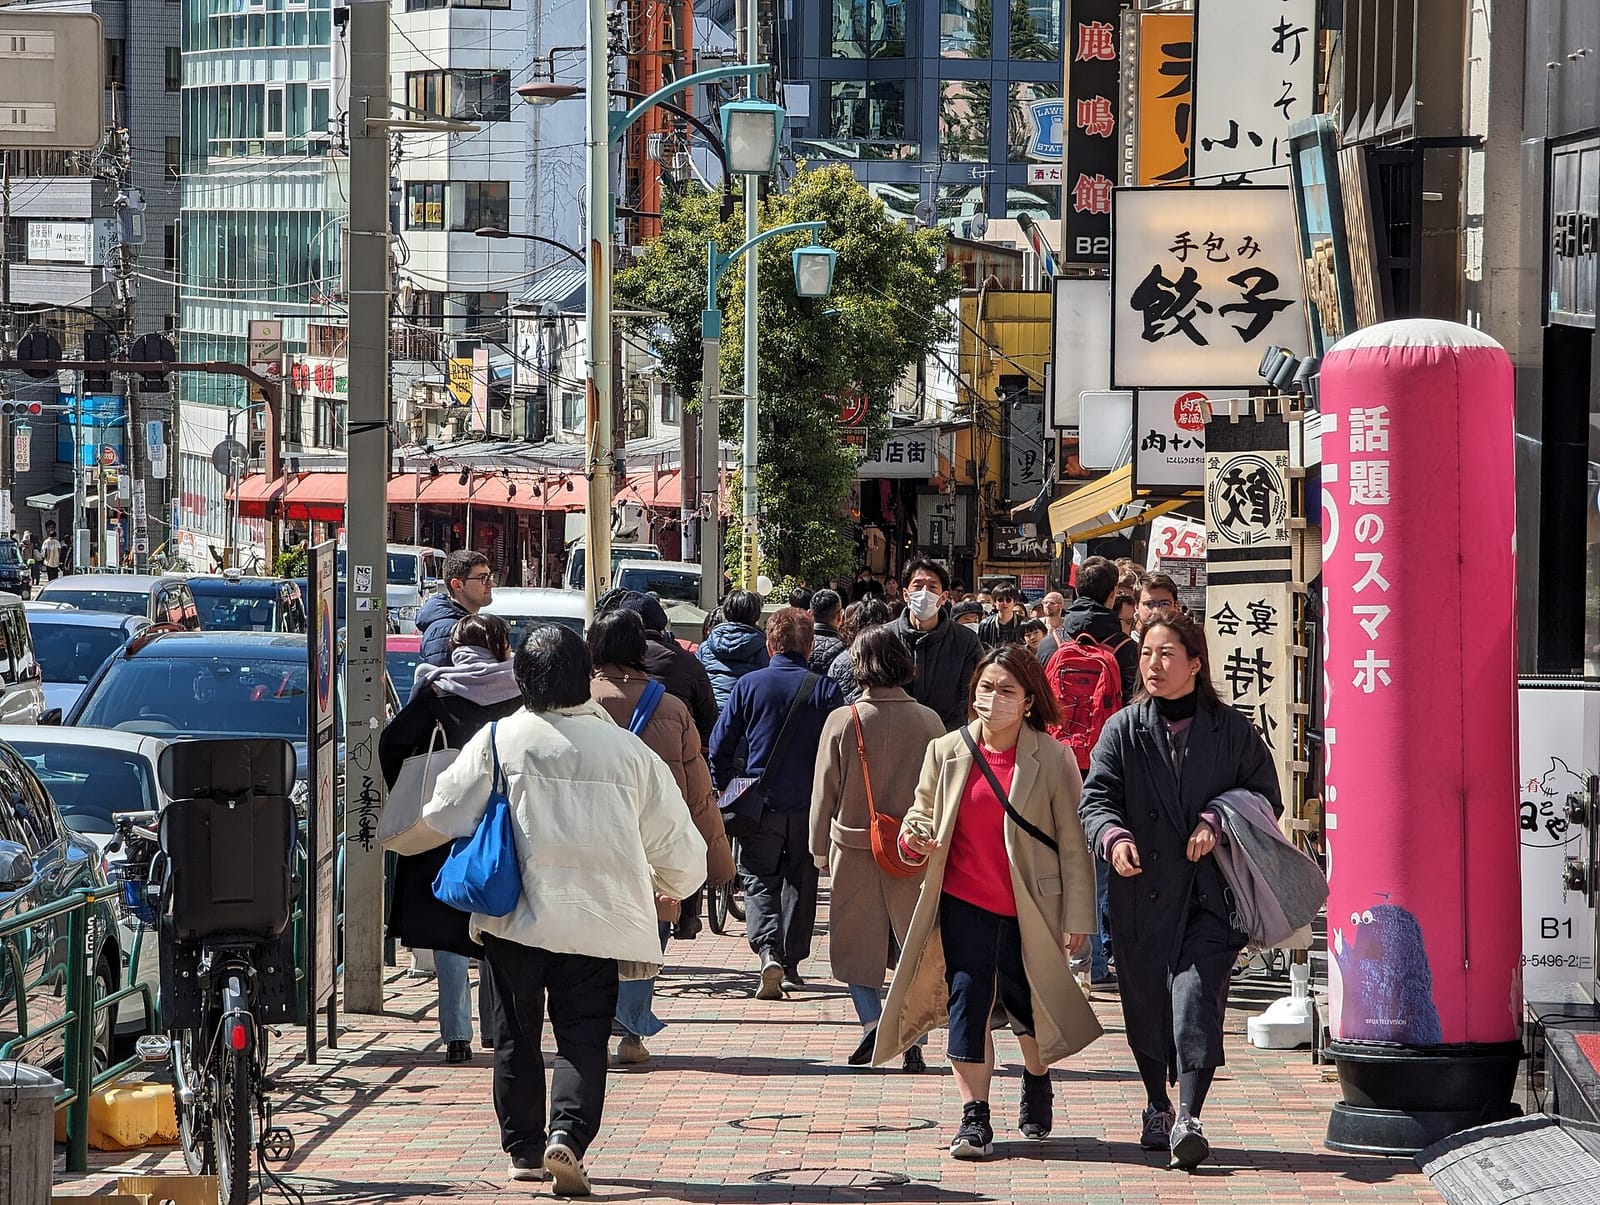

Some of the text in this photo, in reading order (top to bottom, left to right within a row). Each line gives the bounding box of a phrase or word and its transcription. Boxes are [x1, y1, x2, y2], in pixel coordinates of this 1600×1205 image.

[1072, 21, 1116, 215] 鹿鳴館
[1035, 169, 1063, 180] 酒・た
[1076, 236, 1109, 254] B2
[1168, 231, 1262, 263] 手包み
[1130, 264, 1296, 347] 餃子
[1178, 413, 1204, 424] 居酒
[1348, 405, 1392, 694] 話題のスマホ
[1541, 917, 1571, 939] B1
[1520, 954, 1578, 968] 3-5496-2
